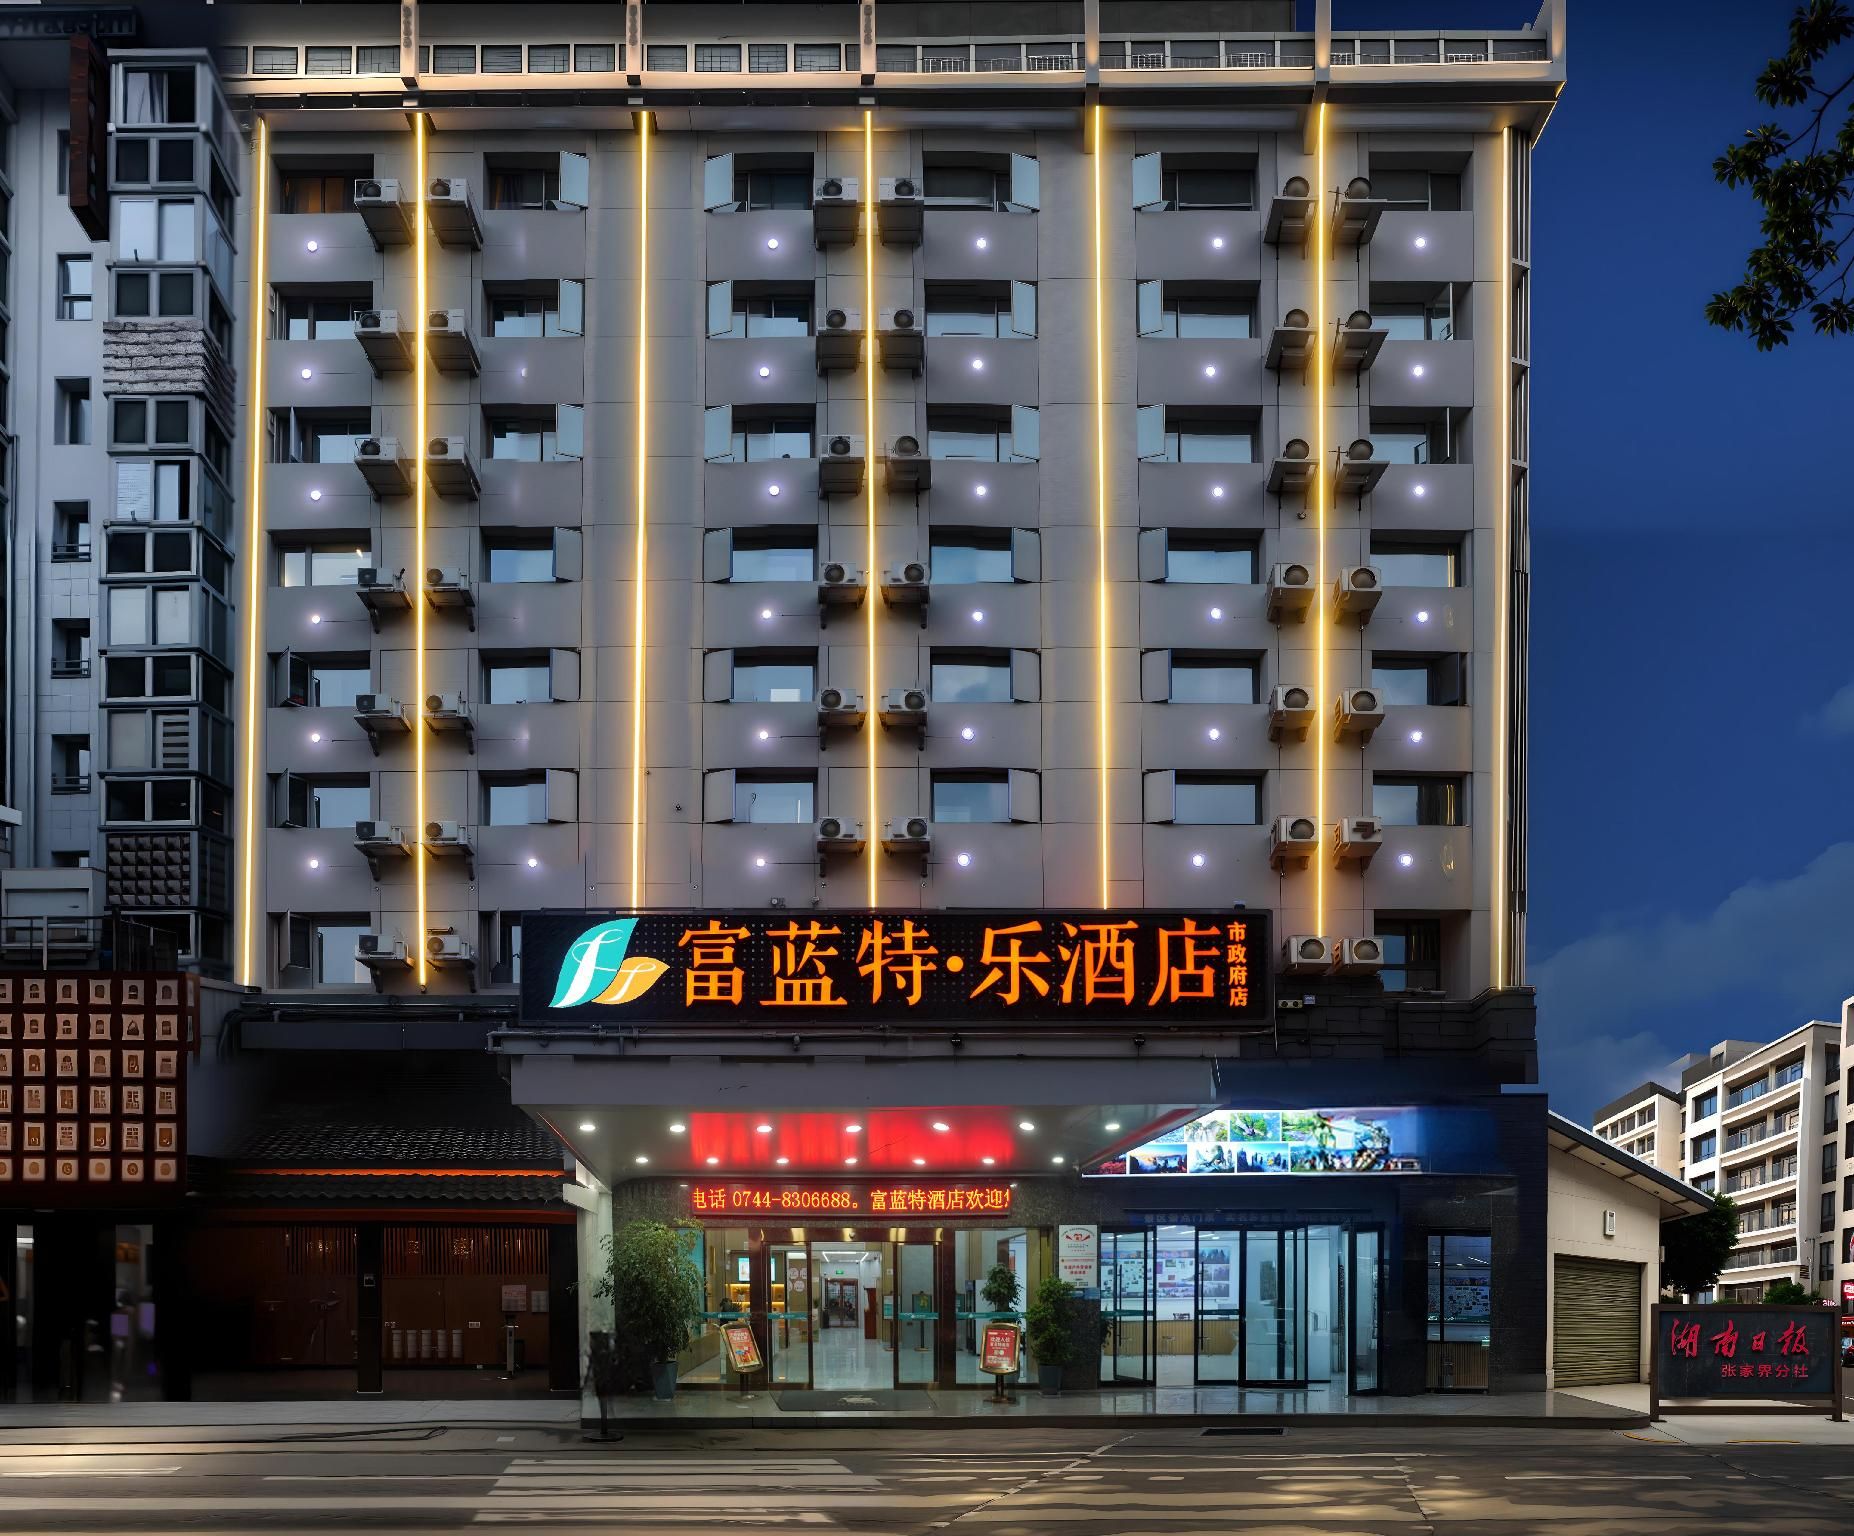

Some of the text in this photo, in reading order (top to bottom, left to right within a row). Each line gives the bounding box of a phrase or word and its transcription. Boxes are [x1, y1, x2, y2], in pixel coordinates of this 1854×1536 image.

[679, 918, 1221, 1007] 富蓝特·乐酒店
[1227, 921, 1249, 1007] 市政府店
[692, 1187, 727, 1209] 电话
[1671, 1319, 1809, 1358] 湖南日报
[1720, 1363, 1808, 1378] 张家界分社
